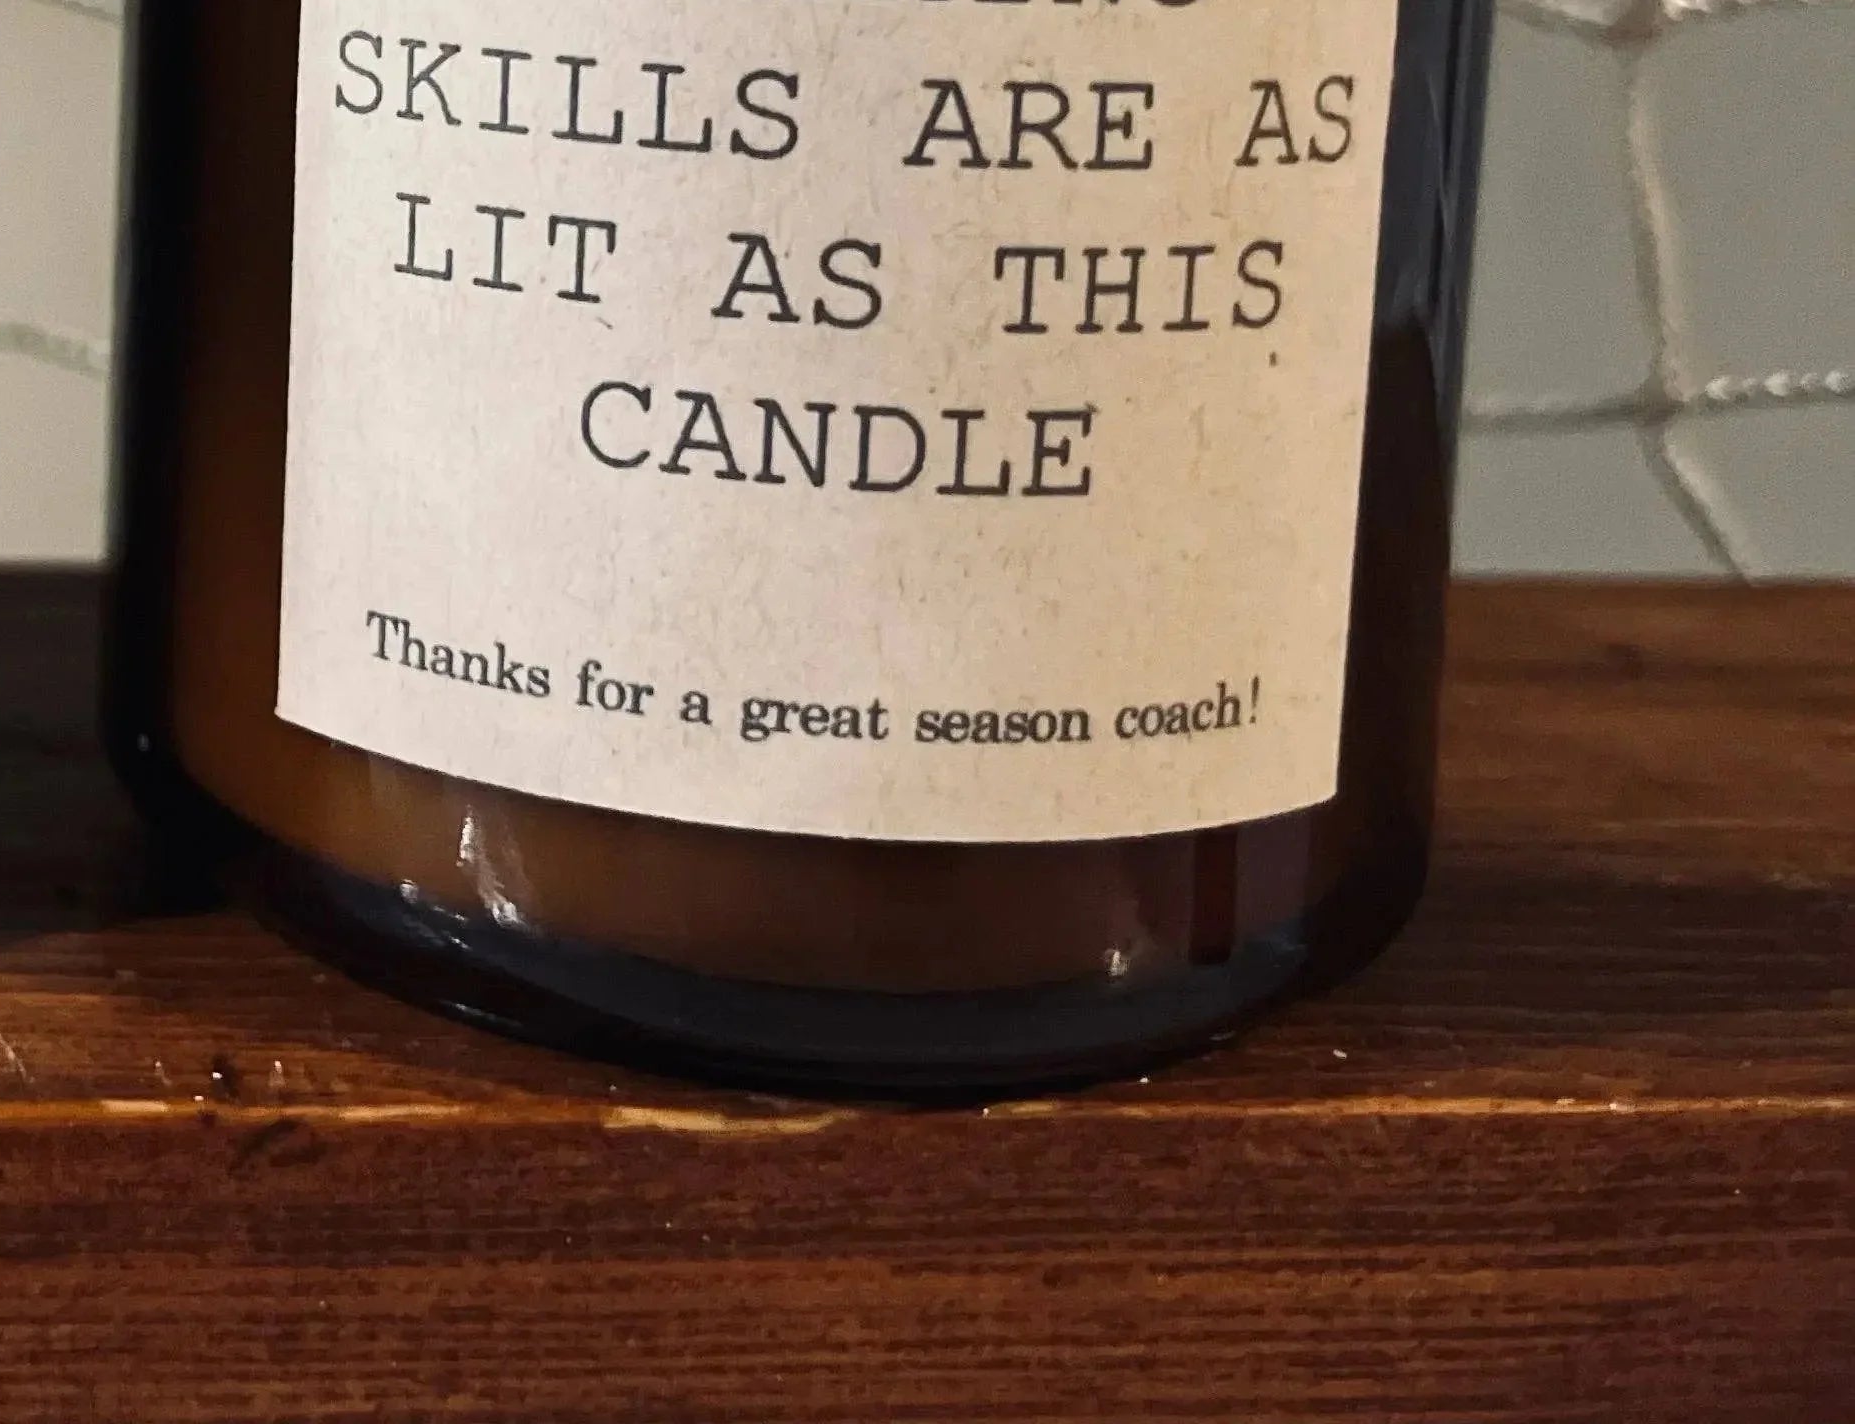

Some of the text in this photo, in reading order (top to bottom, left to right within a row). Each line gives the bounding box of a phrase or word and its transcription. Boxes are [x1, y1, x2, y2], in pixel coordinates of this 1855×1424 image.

[336, 30, 1354, 171] SKILLS ARE AS
[394, 193, 1283, 334] LIT AS THIS
[581, 381, 1098, 497] CANDLE
[366, 611, 1259, 744] Thanks for a great season coach!
